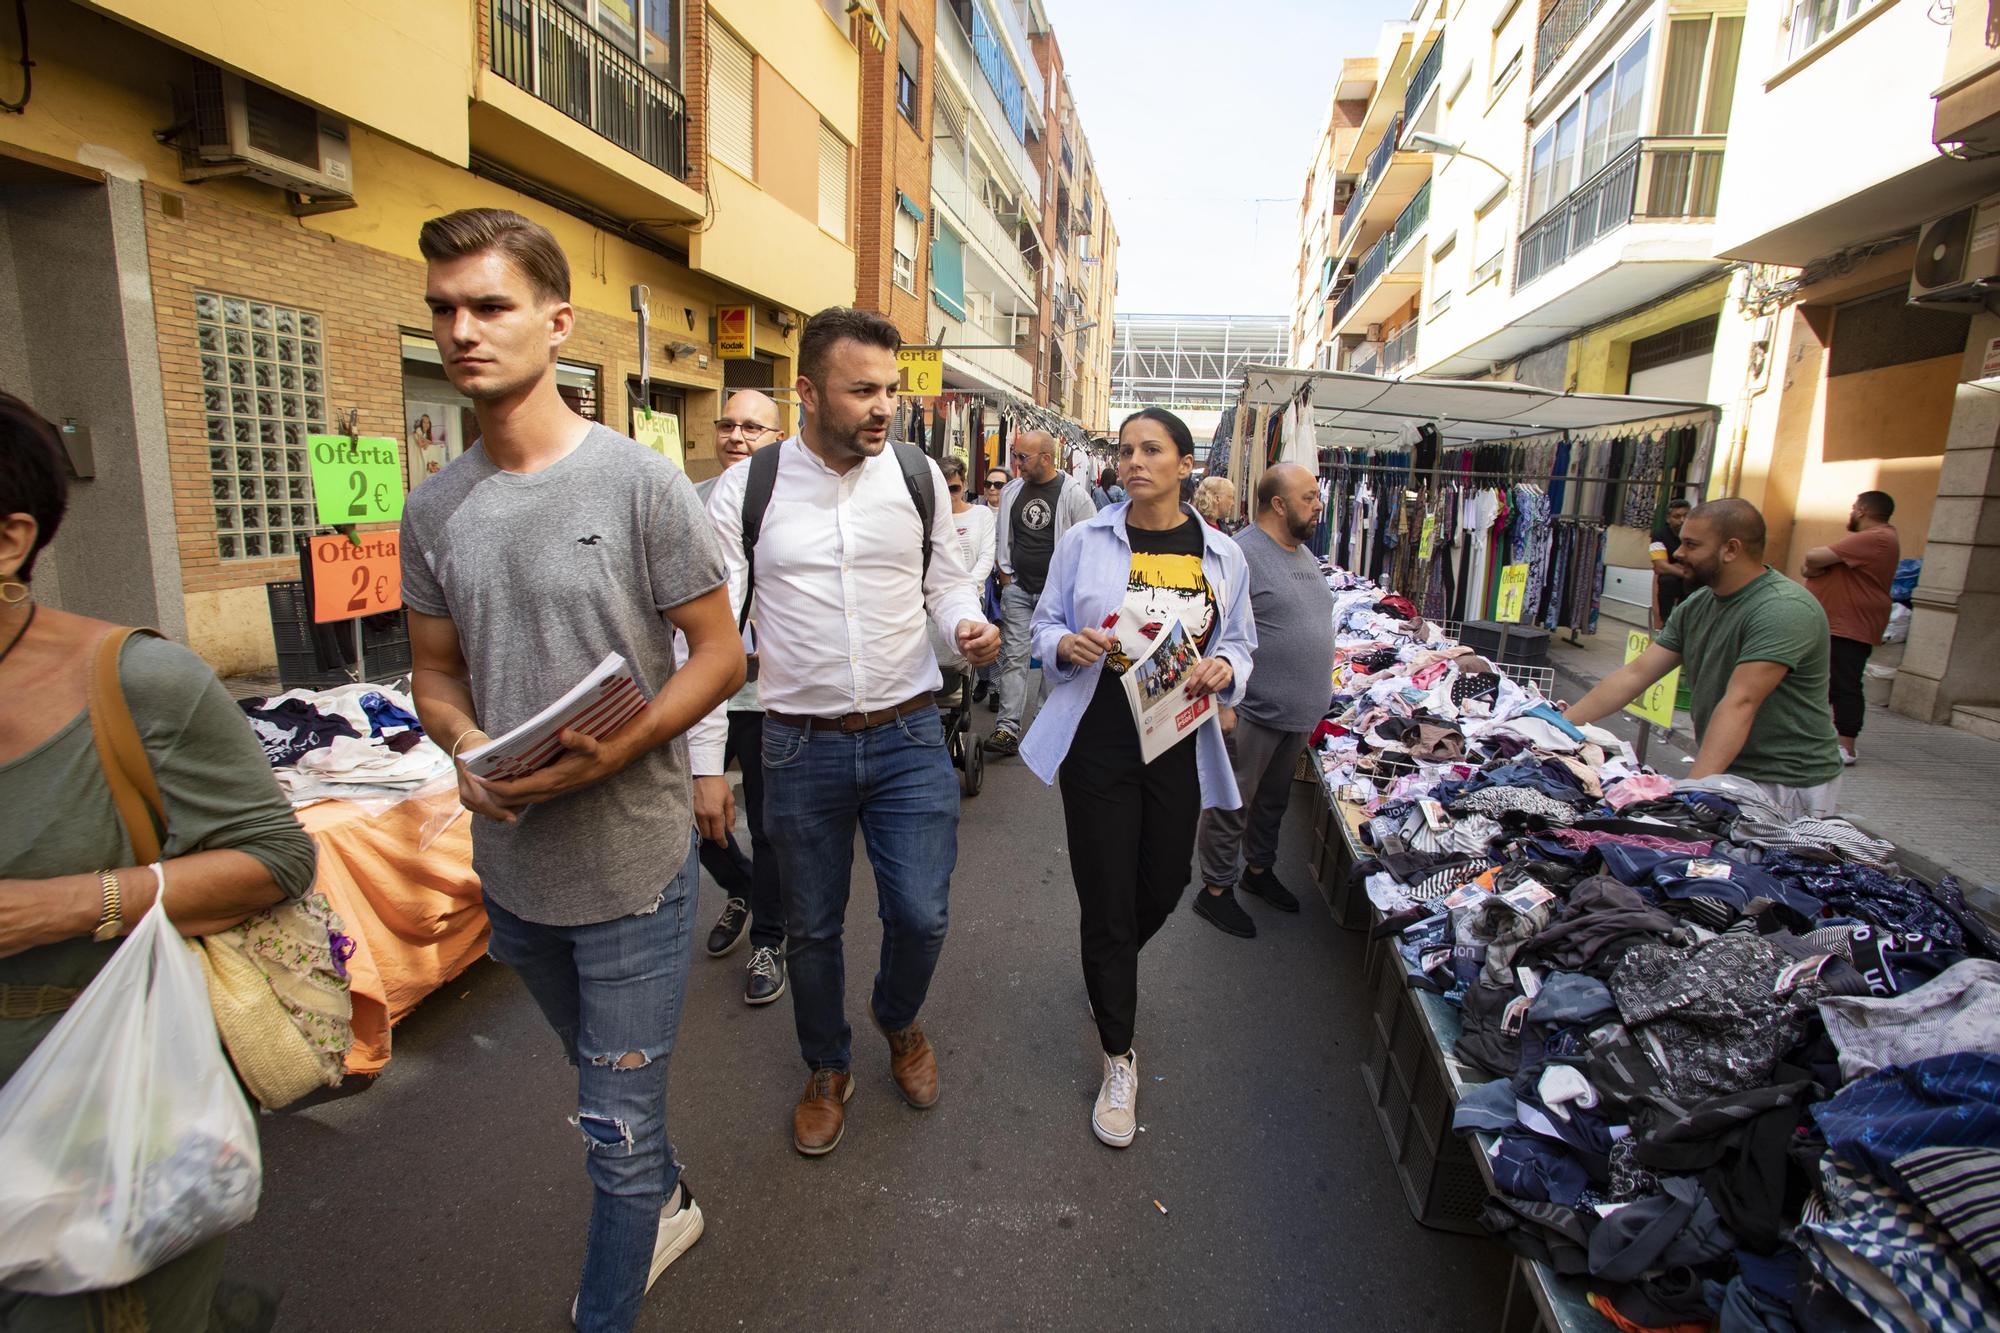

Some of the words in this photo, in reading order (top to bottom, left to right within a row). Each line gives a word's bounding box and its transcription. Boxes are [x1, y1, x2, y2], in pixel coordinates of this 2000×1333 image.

[720, 341, 745, 350] Kodak
[898, 366, 914, 392] 1
[917, 372, 929, 390] €
[314, 442, 396, 465] Oferta
[348, 470, 368, 516] 2
[374, 483, 391, 512] €
[318, 541, 397, 563] Oferta
[347, 565, 370, 612] 2
[375, 575, 389, 604] €
[1652, 684, 1664, 711] €
